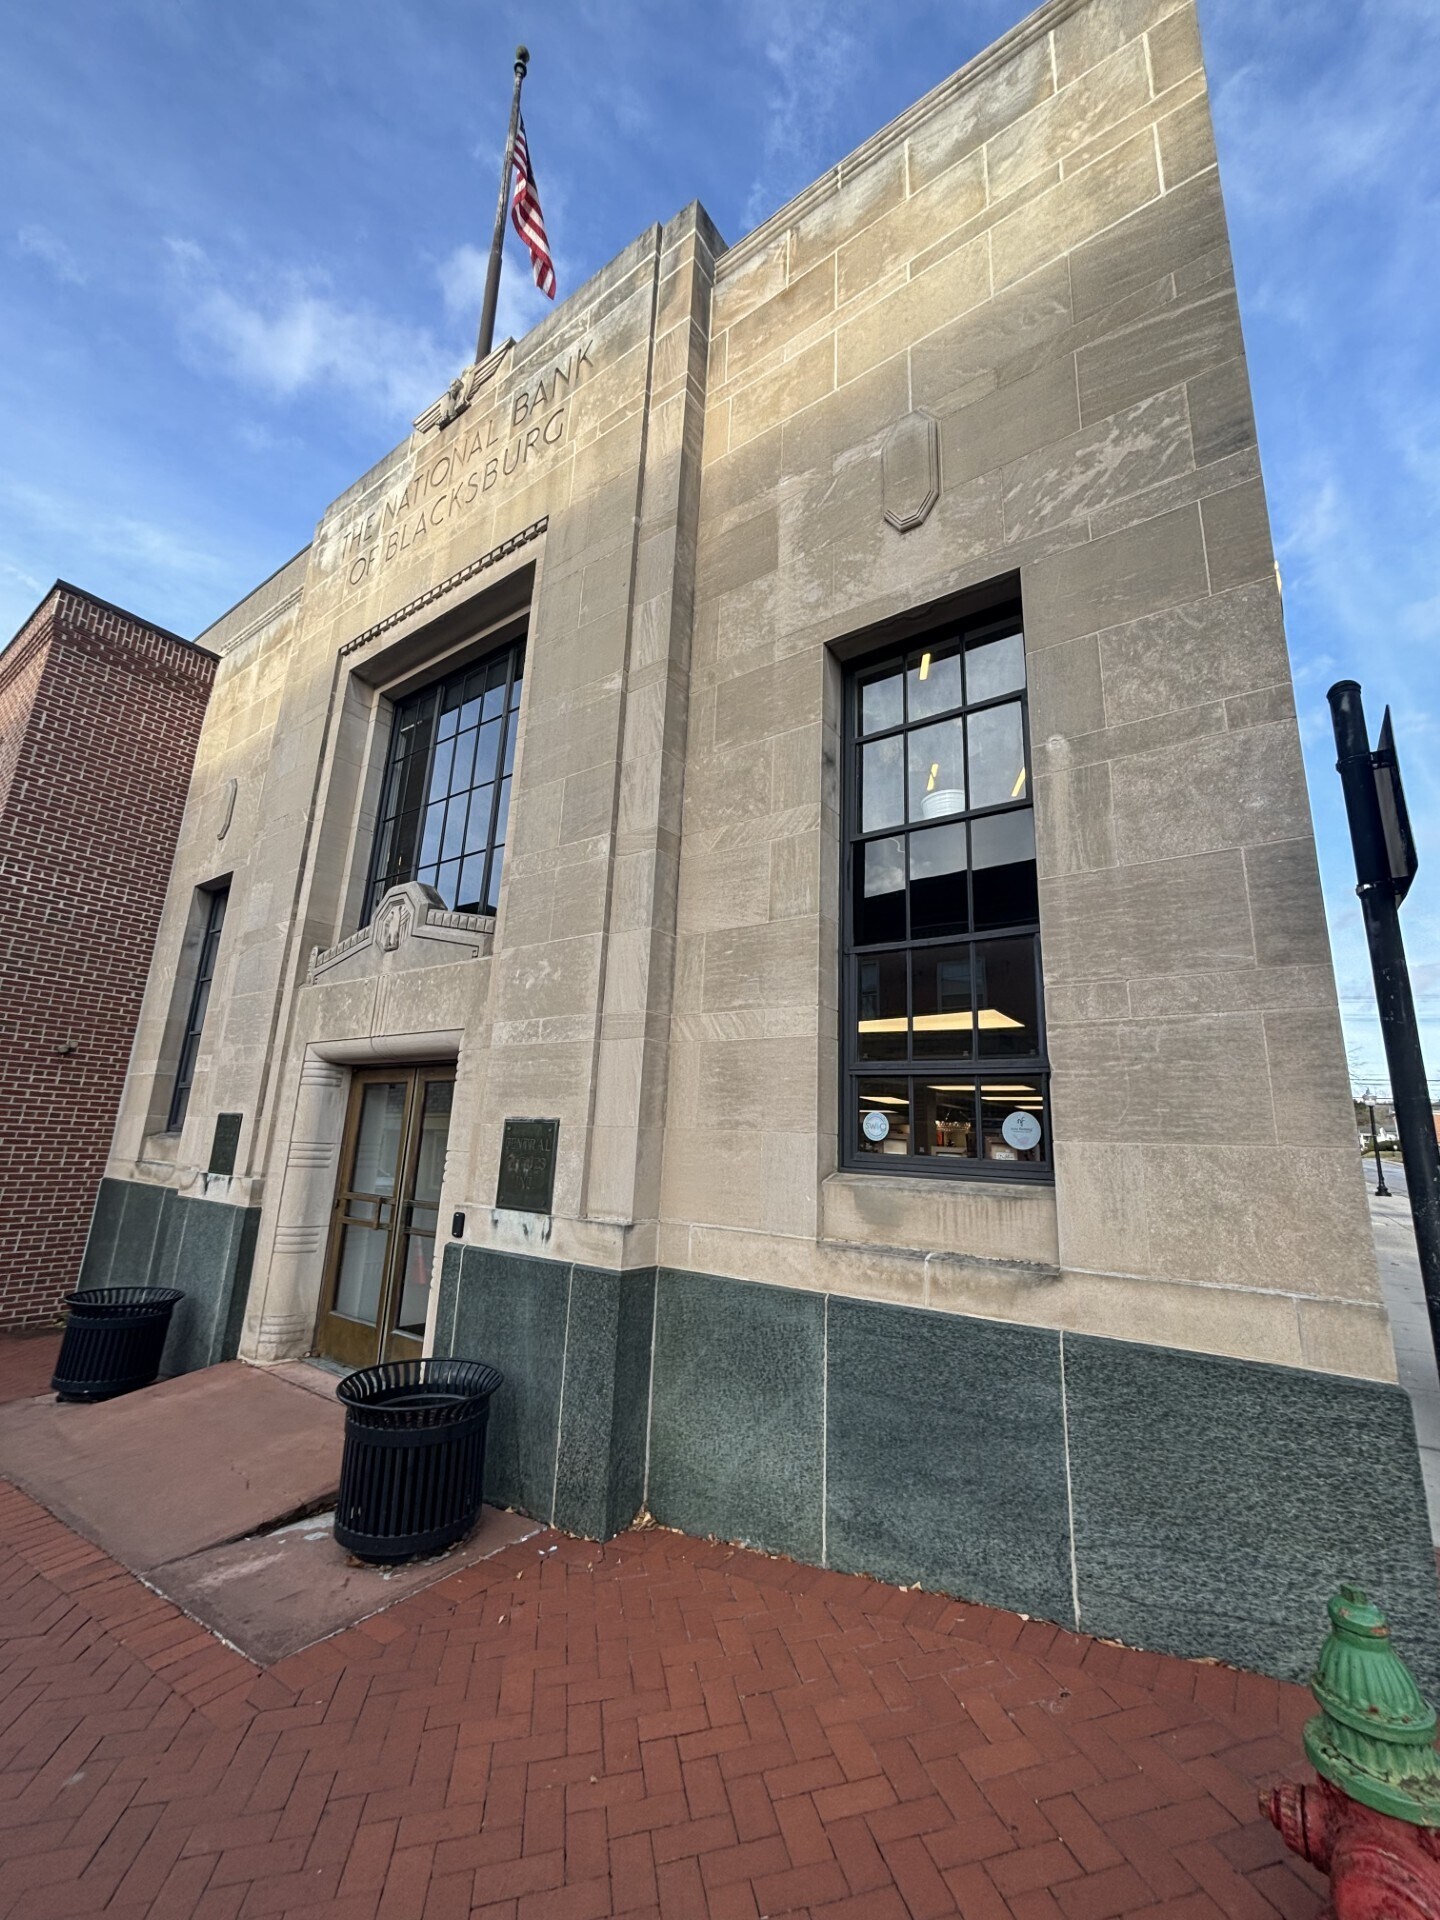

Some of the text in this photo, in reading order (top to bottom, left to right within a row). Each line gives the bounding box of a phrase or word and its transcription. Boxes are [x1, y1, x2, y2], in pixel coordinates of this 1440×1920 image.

[342, 339, 594, 559] THE NATIONAL BANK
[350, 408, 565, 586] OF BLACKSBURG
